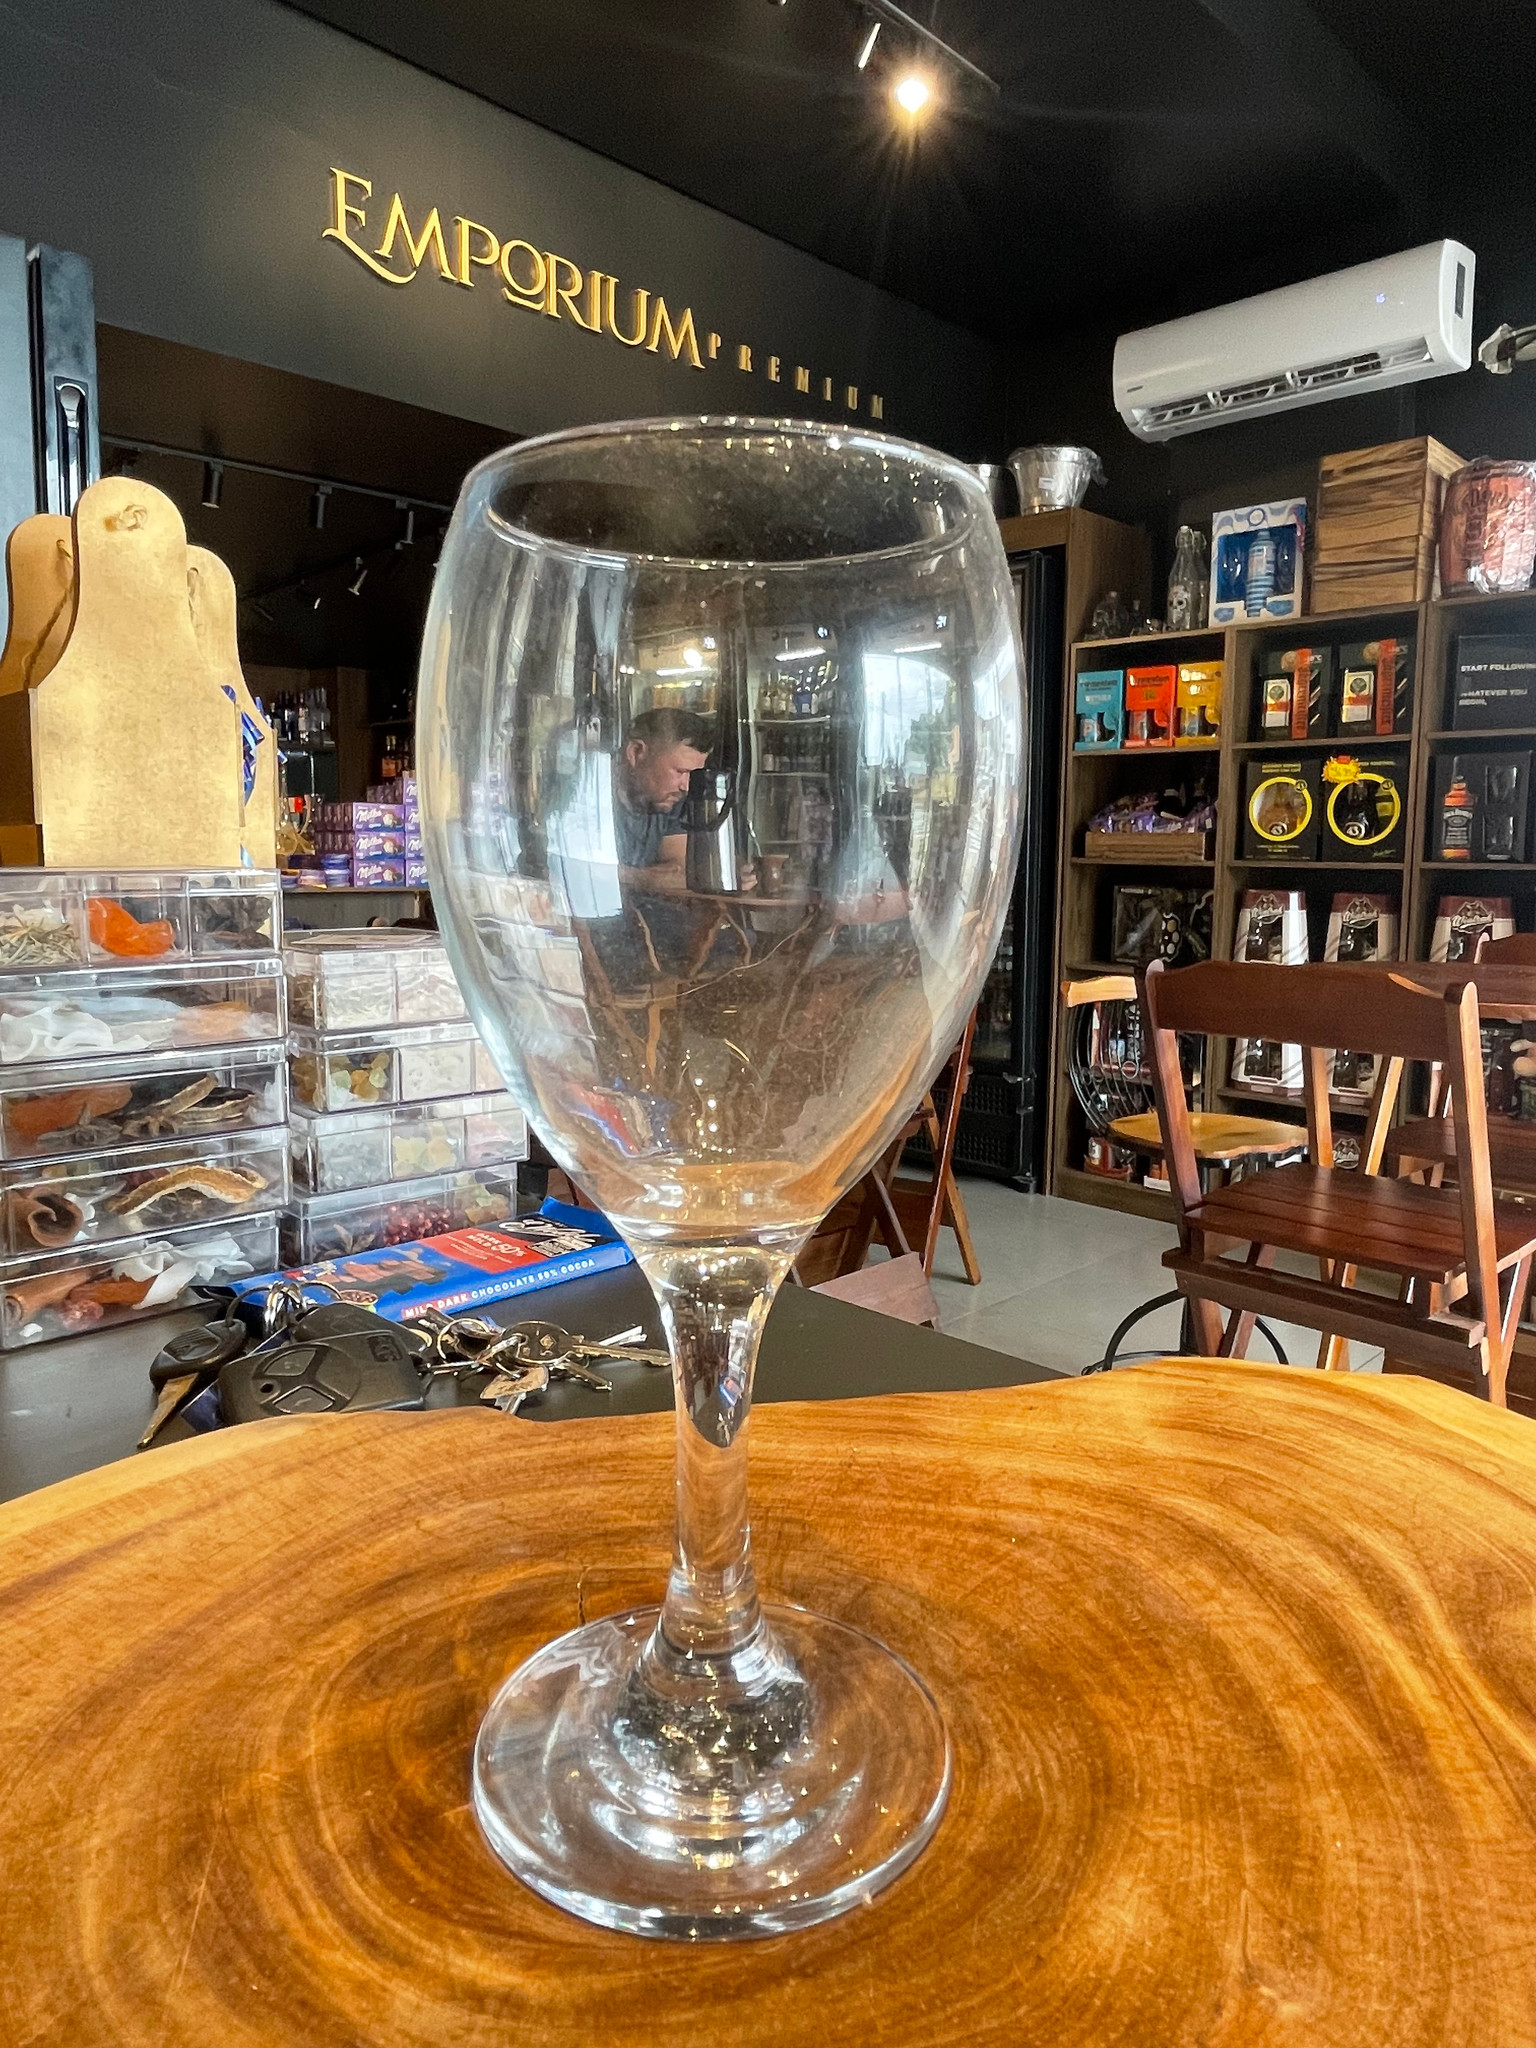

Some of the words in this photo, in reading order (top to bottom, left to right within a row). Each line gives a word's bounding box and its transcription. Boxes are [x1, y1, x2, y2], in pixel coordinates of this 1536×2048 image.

[322, 166, 705, 369] EMPORIUM
[708, 332, 884, 420] PREMIUM
[1460, 664, 1488, 672] START
[438, 1292, 469, 1309] DARK
[471, 1274, 535, 1299] CHOCOLATE
[537, 1268, 558, 1281] 50%
[560, 1258, 596, 1275] COCOA
